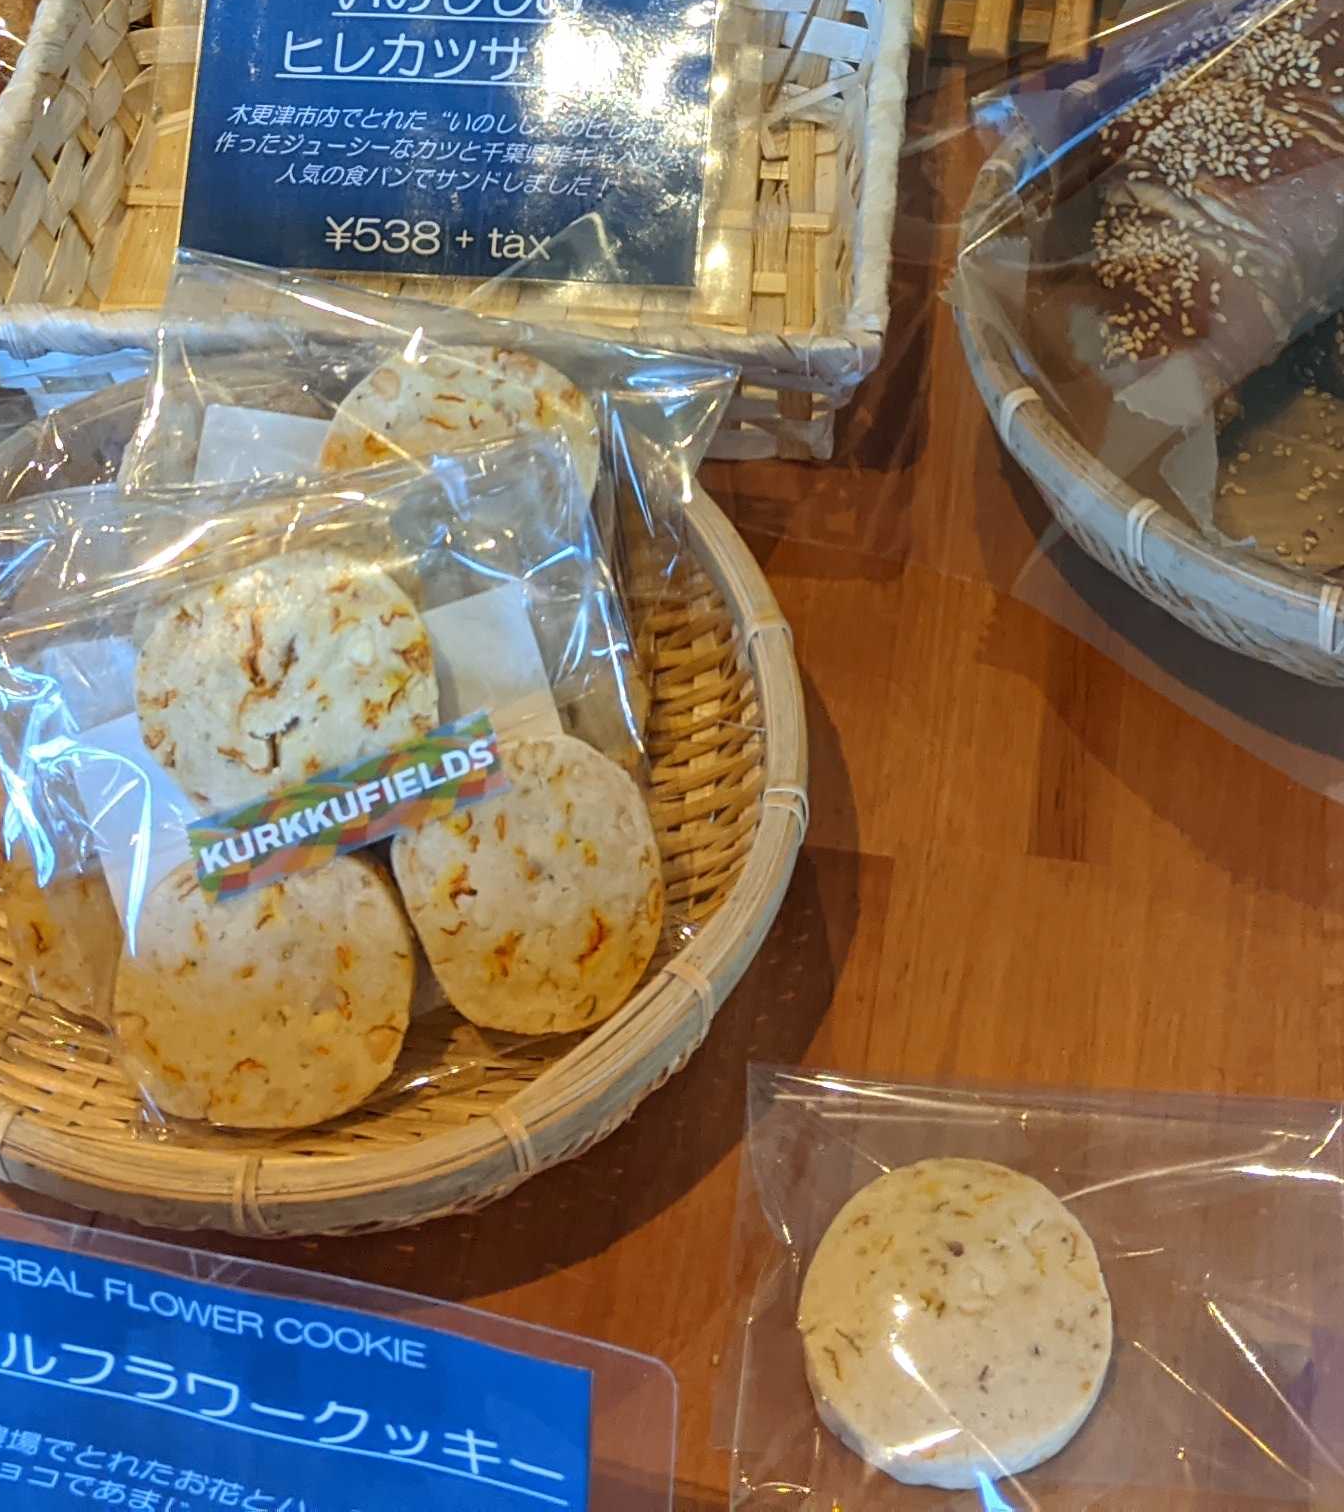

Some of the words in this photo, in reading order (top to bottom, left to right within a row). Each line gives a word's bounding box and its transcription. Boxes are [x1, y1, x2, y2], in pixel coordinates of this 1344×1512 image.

[324, 214, 442, 254] ¥538
[487, 228, 553, 261] tax
[199, 737, 496, 875] KURKKUFIELDS
[102, 1277, 266, 1342] FLOWER
[272, 1315, 428, 1373] COOKIE
